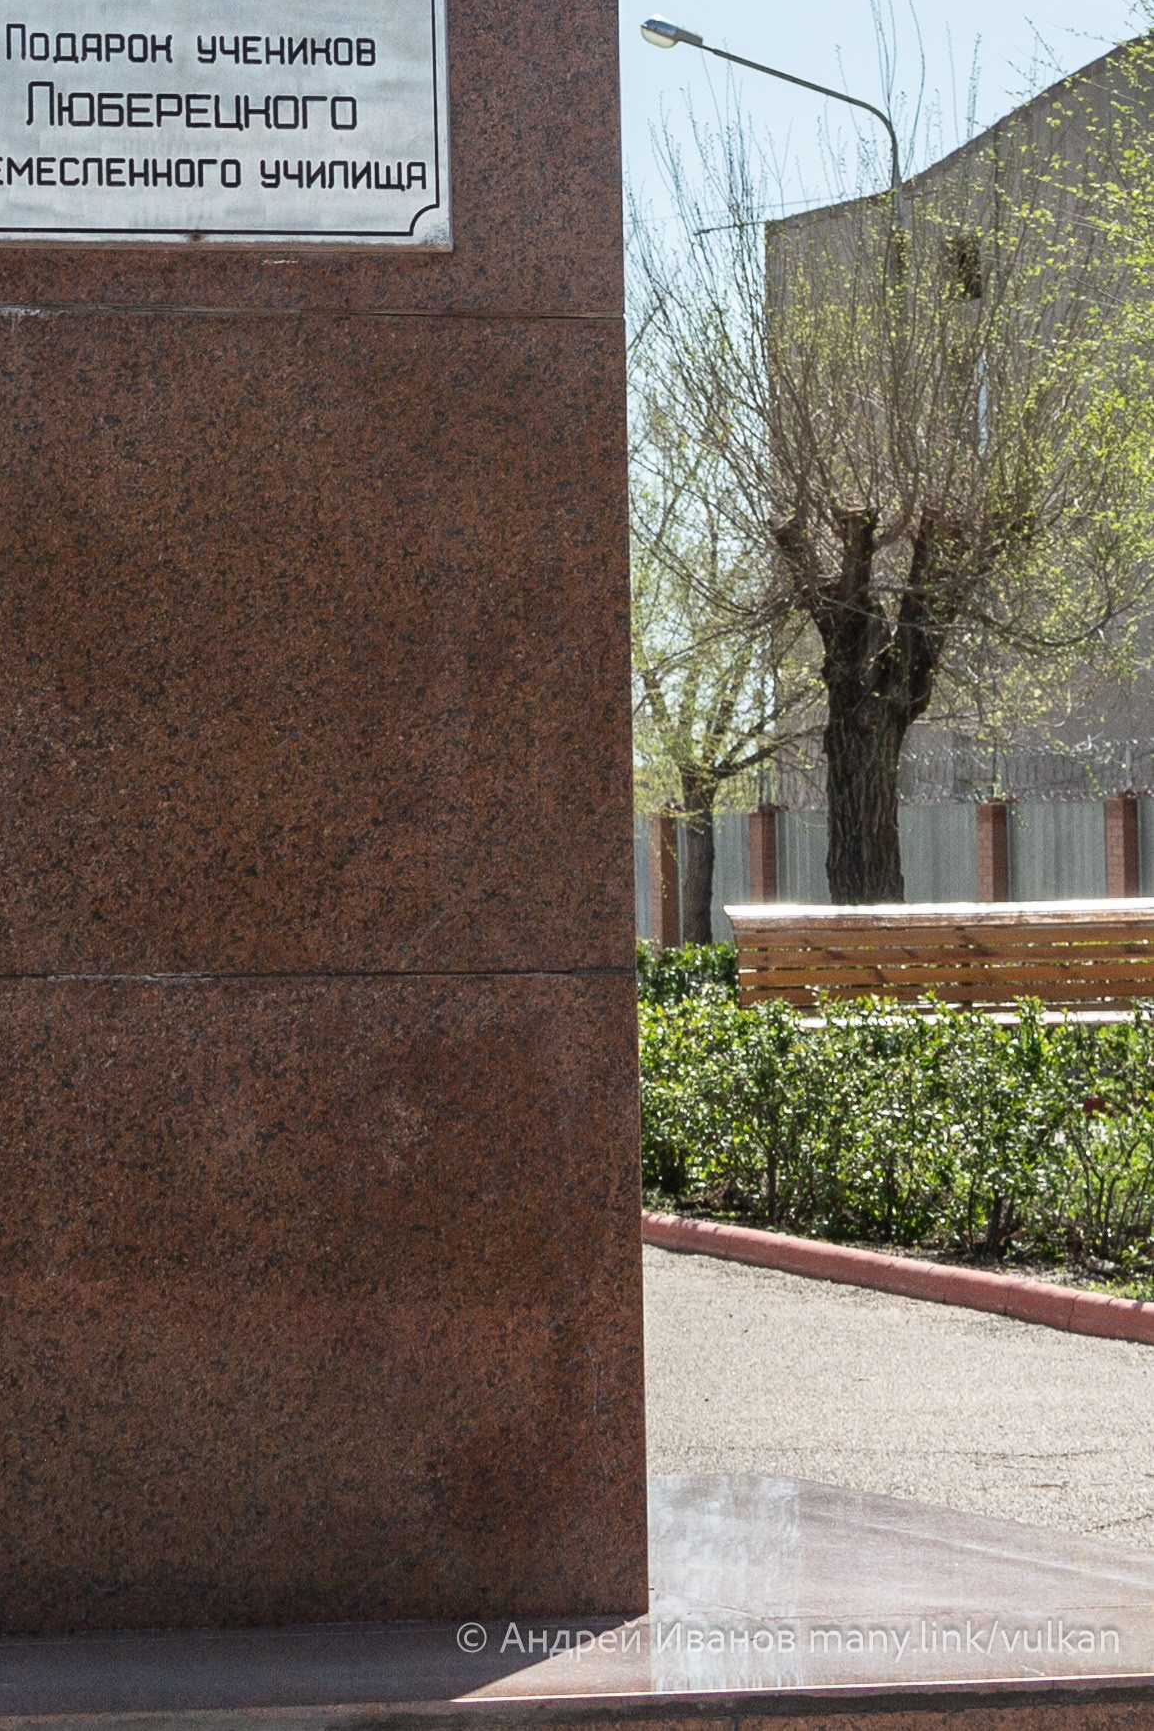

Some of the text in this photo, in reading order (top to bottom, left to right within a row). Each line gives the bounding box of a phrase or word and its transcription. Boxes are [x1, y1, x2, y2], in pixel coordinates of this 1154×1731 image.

[5, 23, 377, 67] ПОДАРОК УЧЕНИКОВ
[25, 81, 358, 131] ЛЮБЕРЕЦКОГО
[259, 159, 427, 192] УЧИЛИЩА
